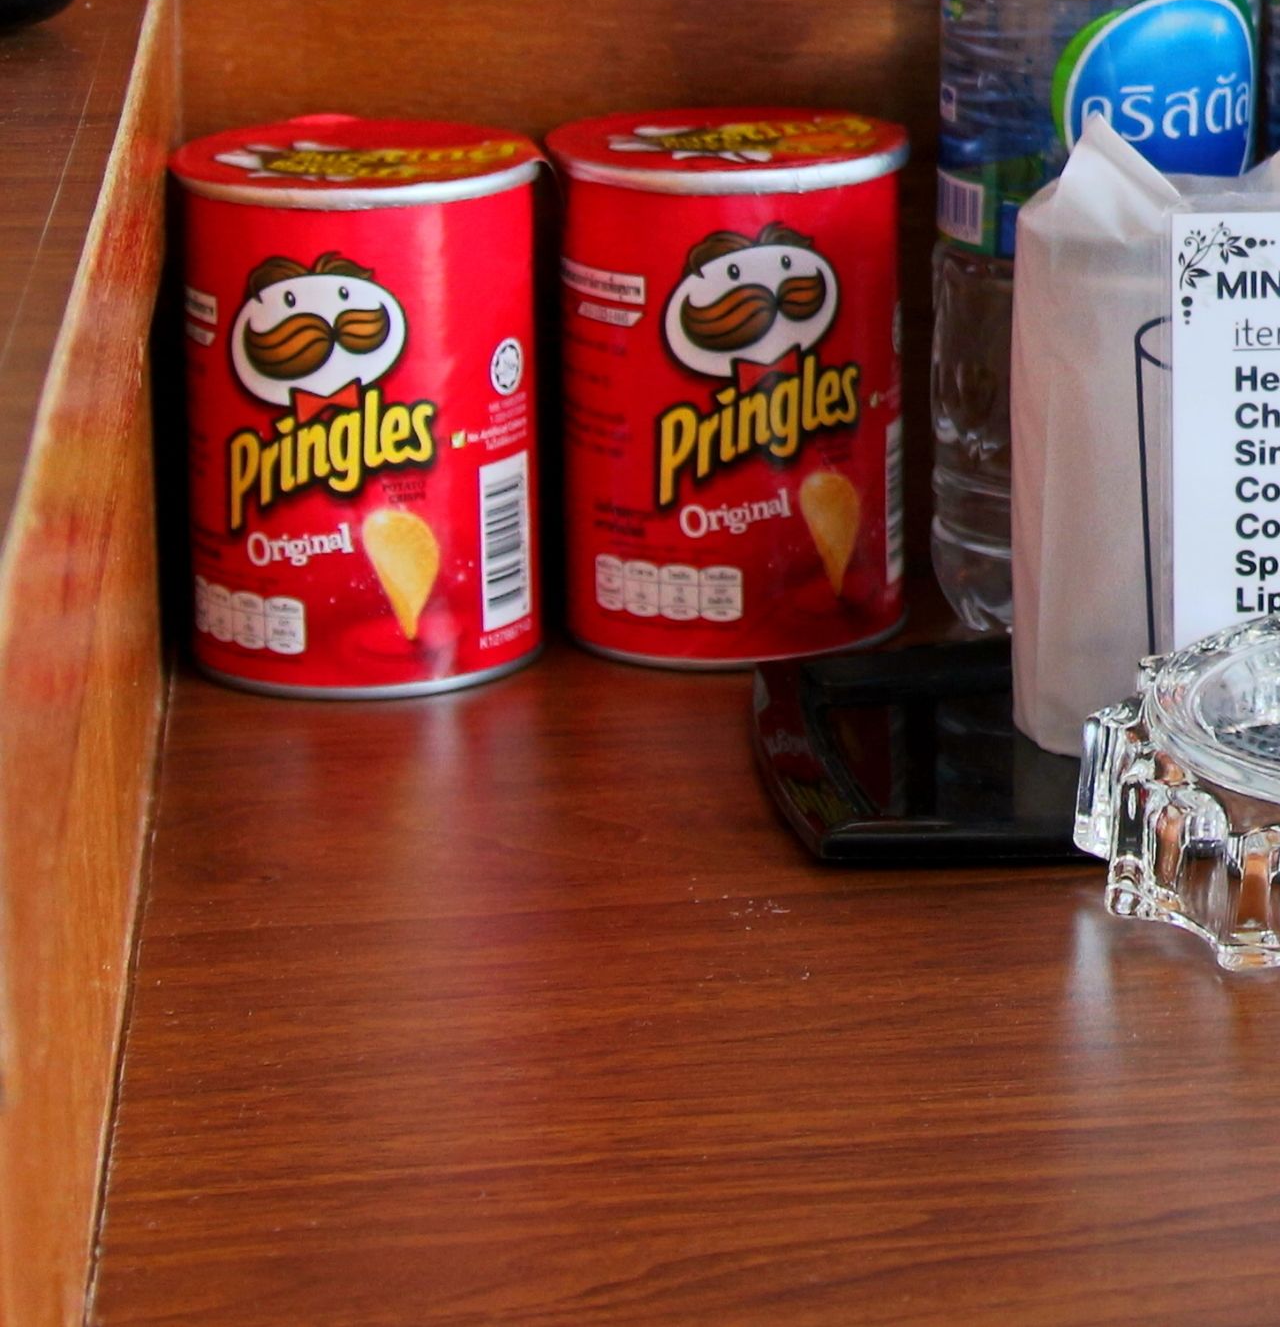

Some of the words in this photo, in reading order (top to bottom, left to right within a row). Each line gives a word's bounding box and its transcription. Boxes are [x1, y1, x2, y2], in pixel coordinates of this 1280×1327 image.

[230, 388, 435, 531] Pringles
[659, 354, 859, 506] Pringles
[247, 522, 354, 567] Original
[679, 487, 791, 539] Original
